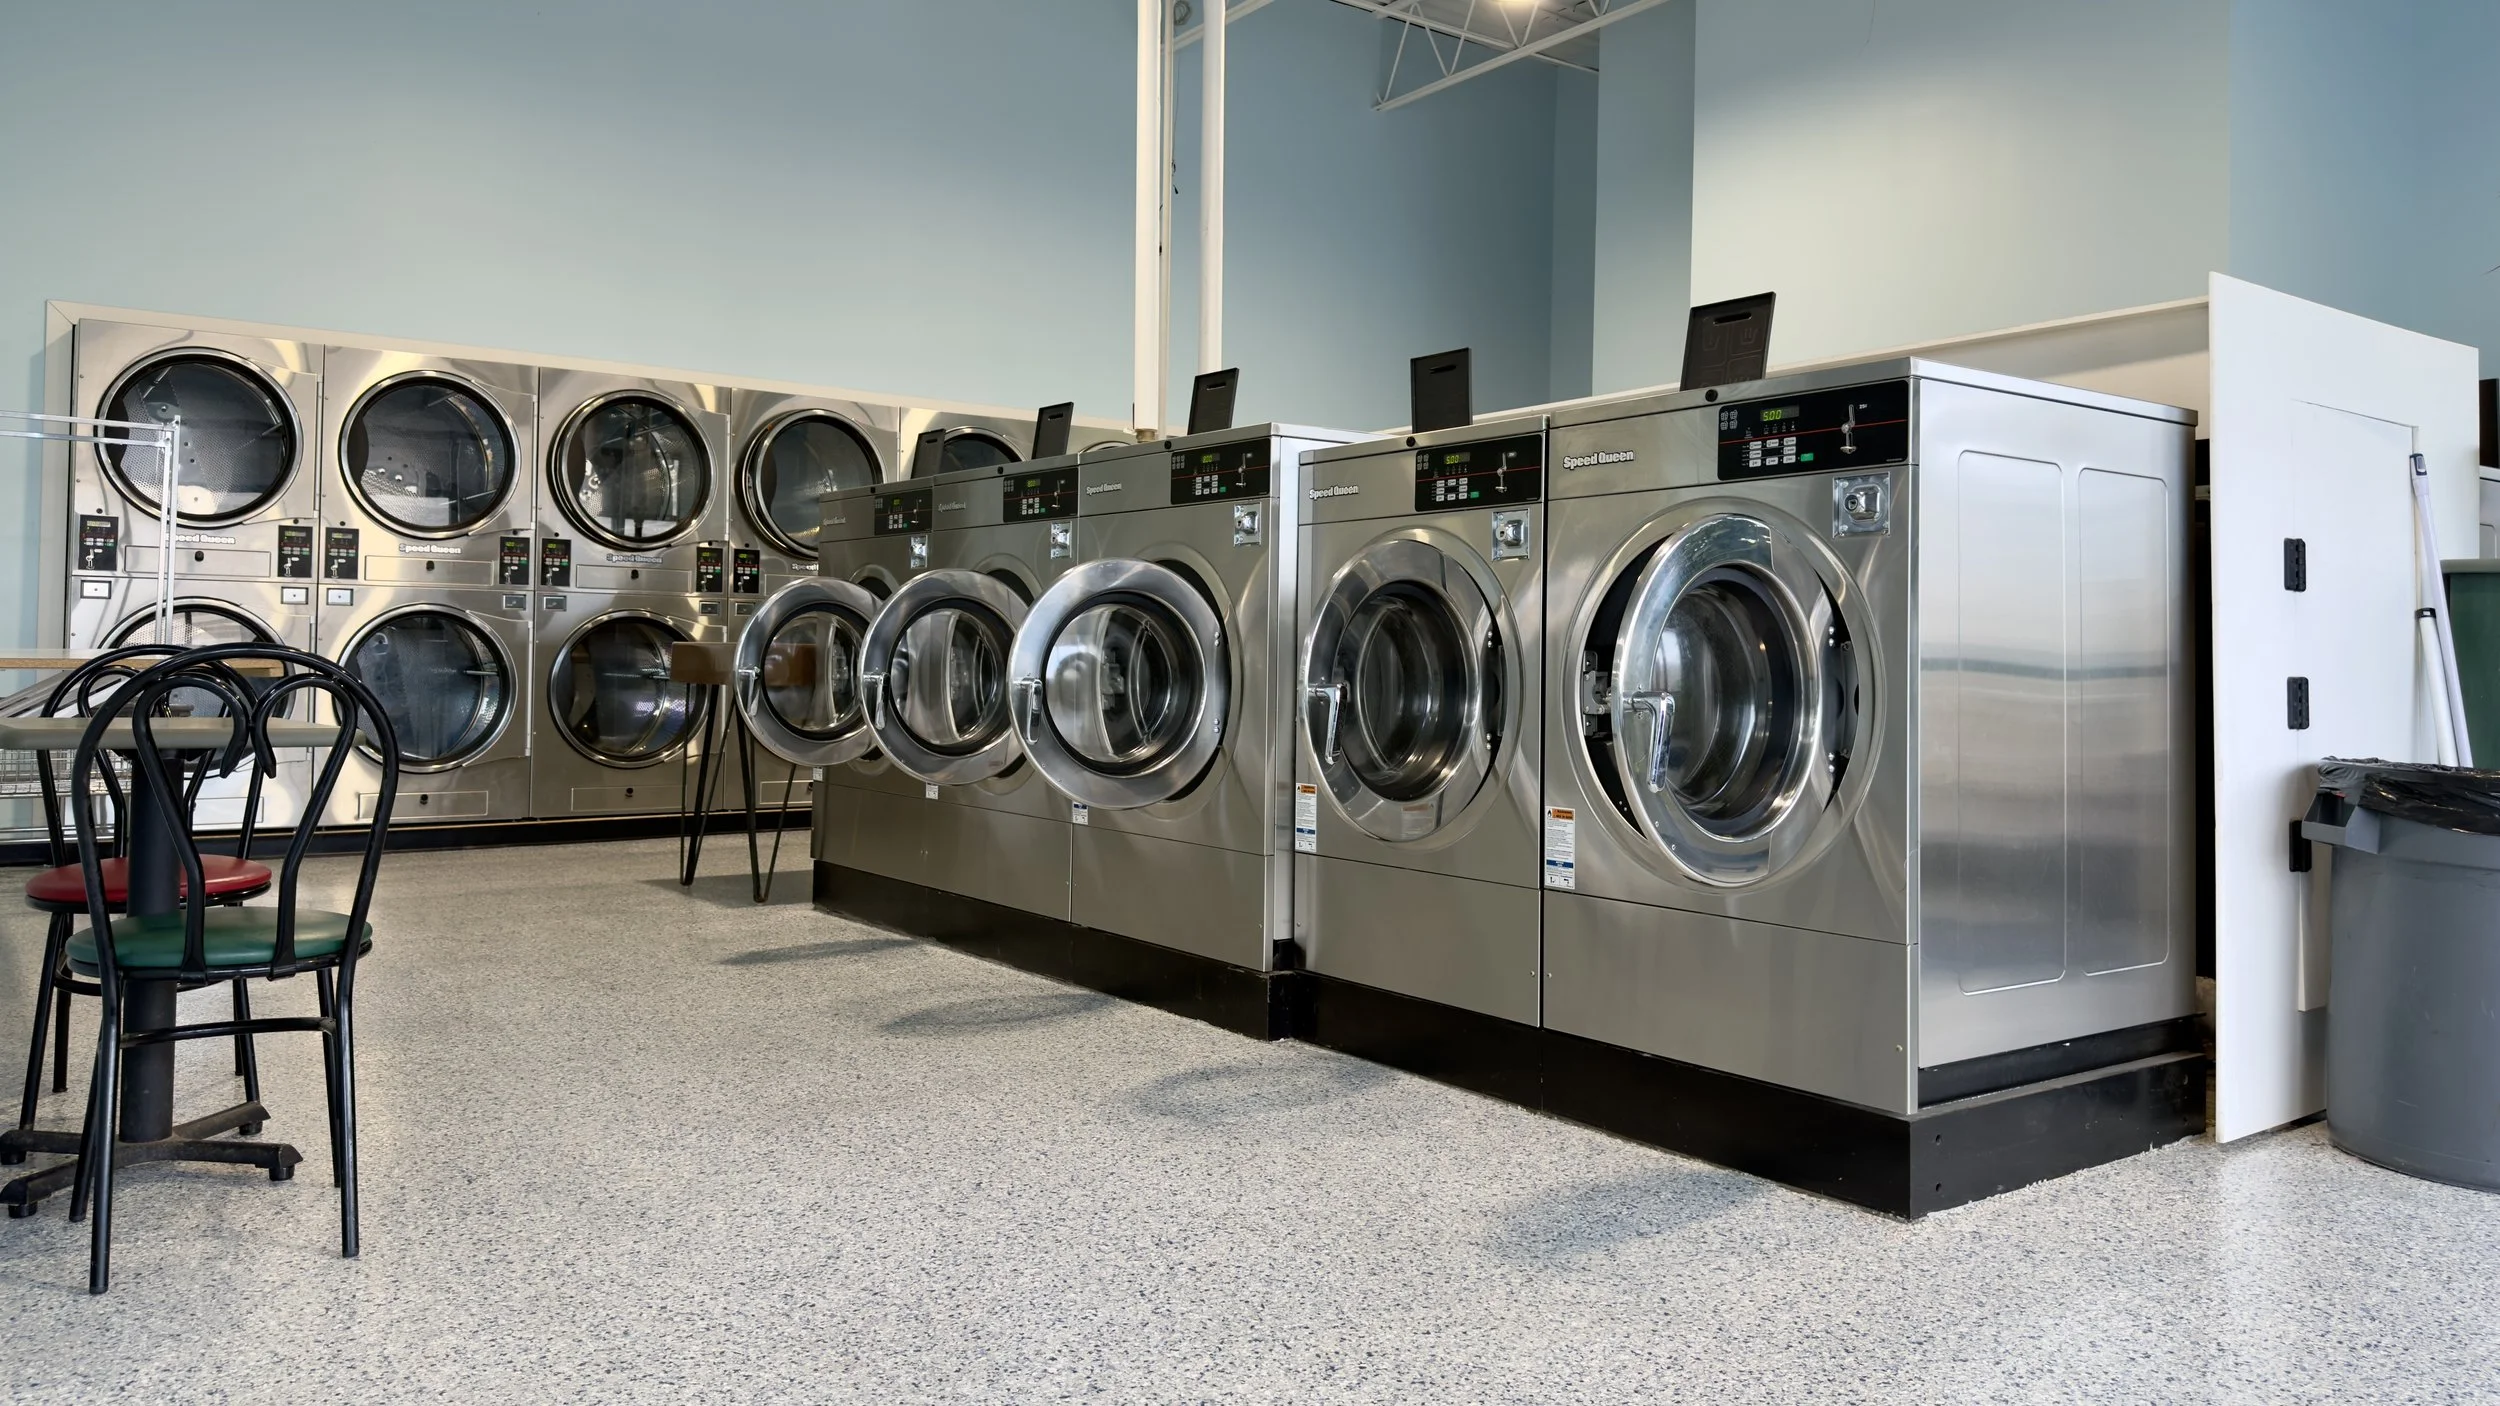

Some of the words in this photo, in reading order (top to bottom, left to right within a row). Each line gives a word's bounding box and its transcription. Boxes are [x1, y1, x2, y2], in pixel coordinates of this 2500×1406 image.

[1563, 452, 1598, 470] Speed
[1598, 450, 1634, 465] Queen
[1309, 486, 1334, 500] Speed
[1334, 485, 1359, 496] Queen
[200, 534, 236, 544] Queen
[399, 543, 430, 553] Speed
[430, 545, 462, 554] Queen
[606, 553, 635, 563] Speed
